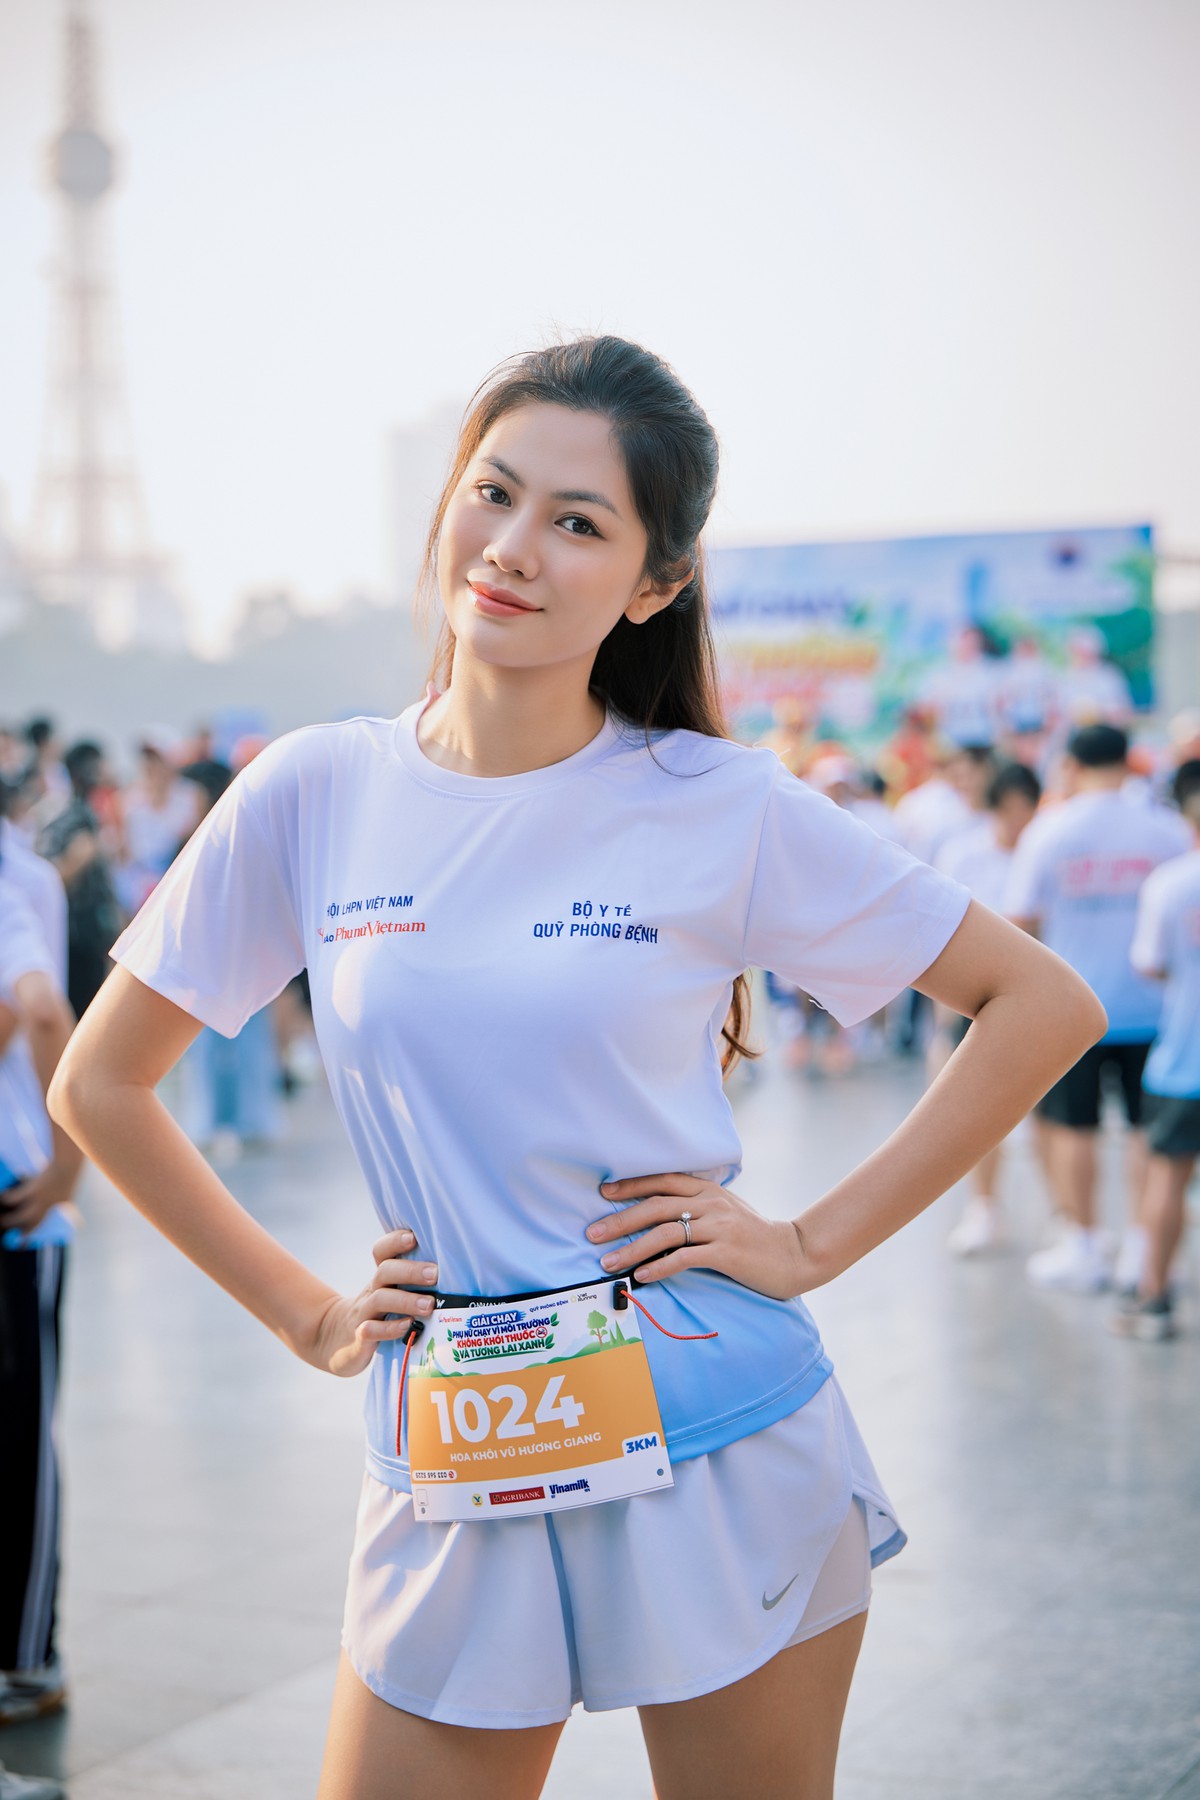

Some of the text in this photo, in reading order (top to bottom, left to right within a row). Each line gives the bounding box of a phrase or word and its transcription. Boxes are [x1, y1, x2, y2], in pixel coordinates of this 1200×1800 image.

[342, 900, 362, 915] LHPN
[366, 895, 386, 911] VIỆT
[388, 895, 413, 908] NAM
[572, 900, 632, 919] BỘ Y TẾ
[533, 920, 658, 944] QUỸ PHÒNG BỆNH
[452, 1317, 551, 1340] PHỤ NỮ CHẠY VÌ MÔI TRƯỜNG
[471, 1314, 489, 1327] GIẢI
[490, 1312, 517, 1324] CHẠY
[457, 1329, 536, 1349] KHÔNG KHÓI THUỐC
[459, 1338, 546, 1359] VÀ TƯƠNG LAI XANH
[430, 1374, 586, 1444] 1024
[450, 1432, 602, 1463] HOA KHÔI VŨ HƯƠNG GIANG
[625, 1435, 658, 1454] 3KM
[501, 1490, 541, 1502] AGRIBANK
[548, 1478, 590, 1495] Vinamilk
